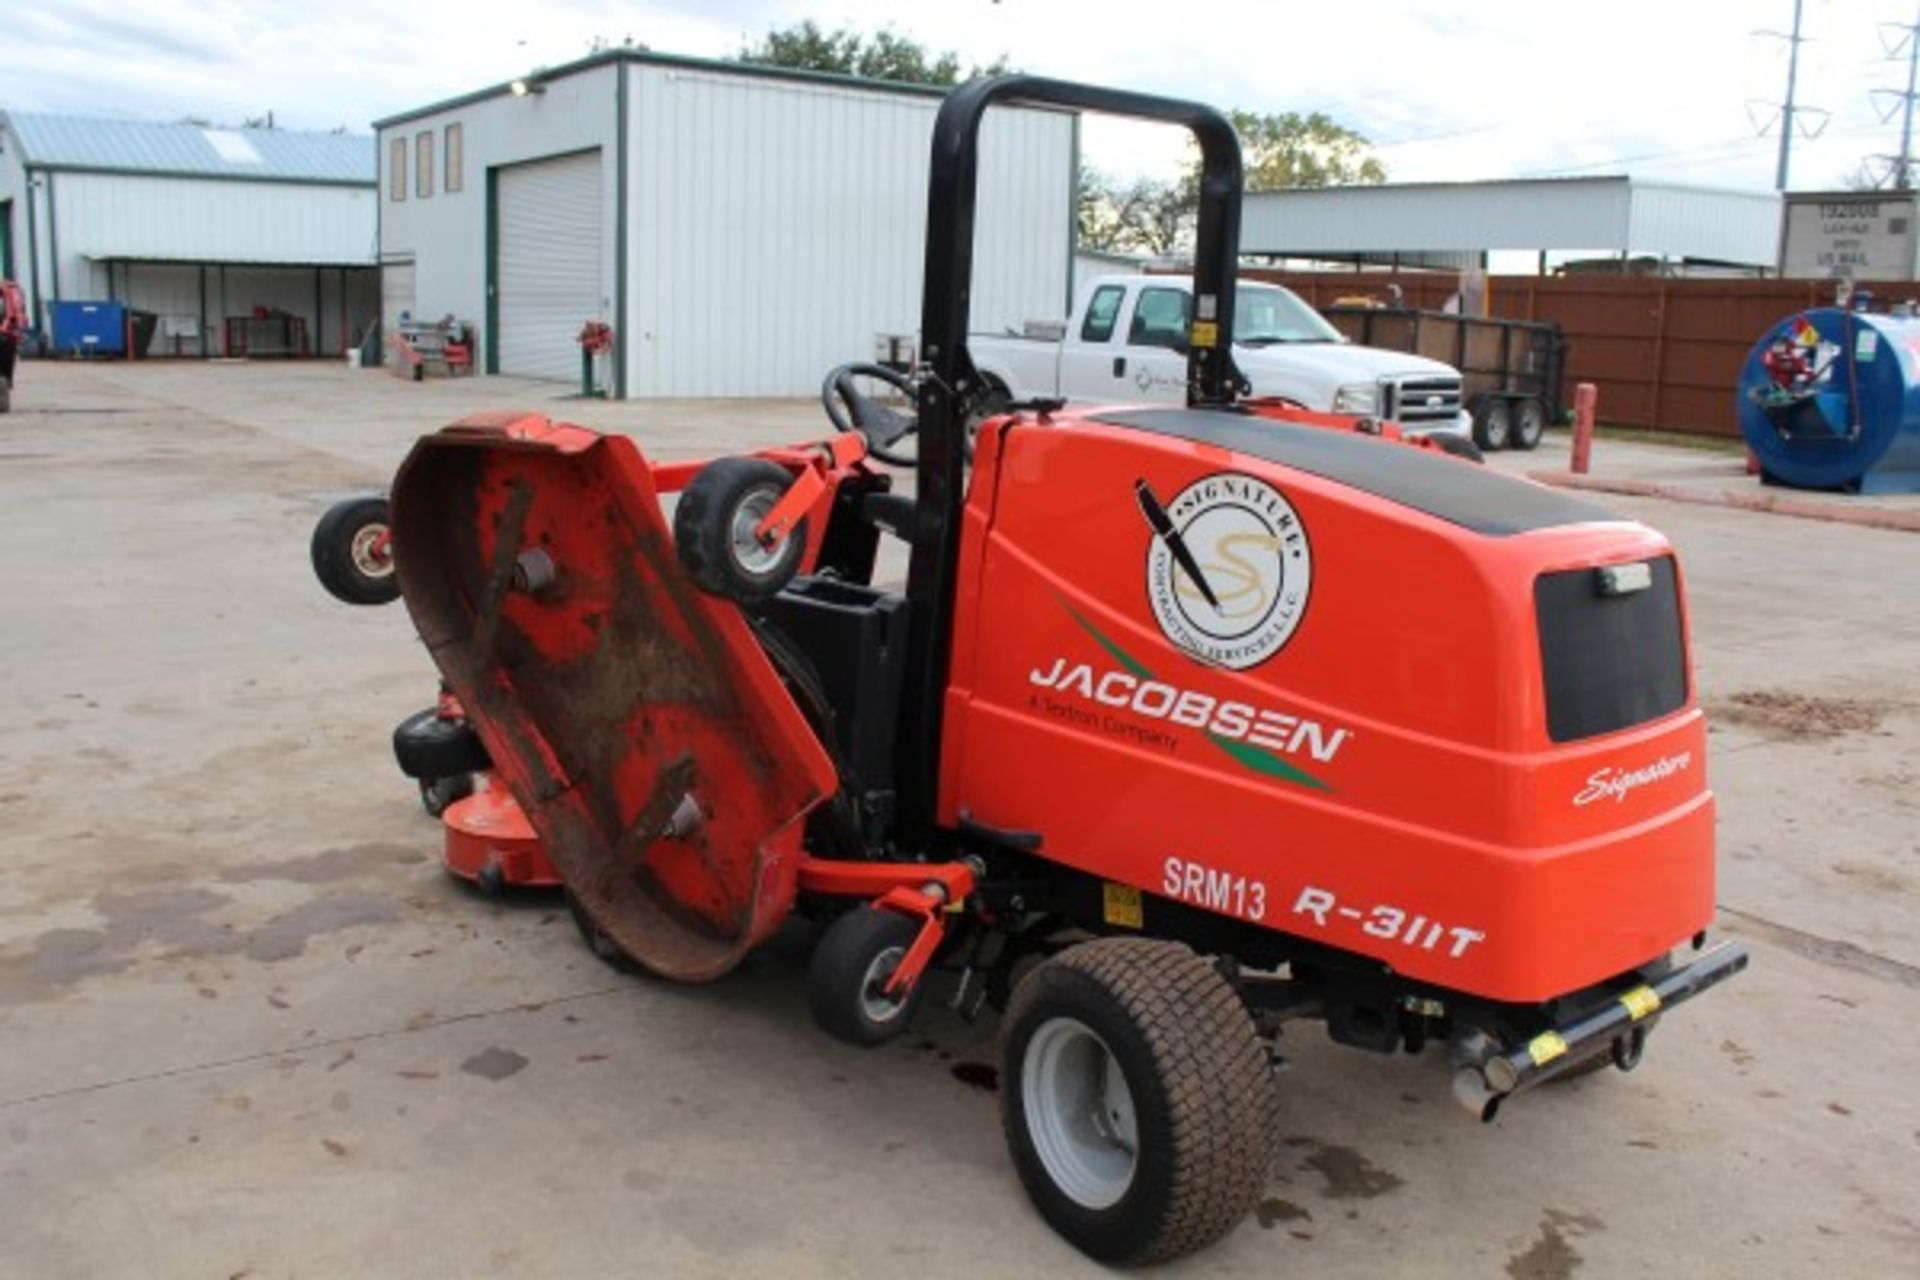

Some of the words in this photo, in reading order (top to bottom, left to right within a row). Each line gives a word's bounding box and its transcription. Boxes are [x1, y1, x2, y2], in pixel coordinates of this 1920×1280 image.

[1182, 479, 1300, 543] SIGNATURE
[1029, 657, 1347, 762] JACOBSEN
[1103, 715, 1178, 751] Company
[1573, 751, 1691, 806] Signature
[1162, 856, 1266, 921] SRM13
[1292, 885, 1485, 957] R-311T
